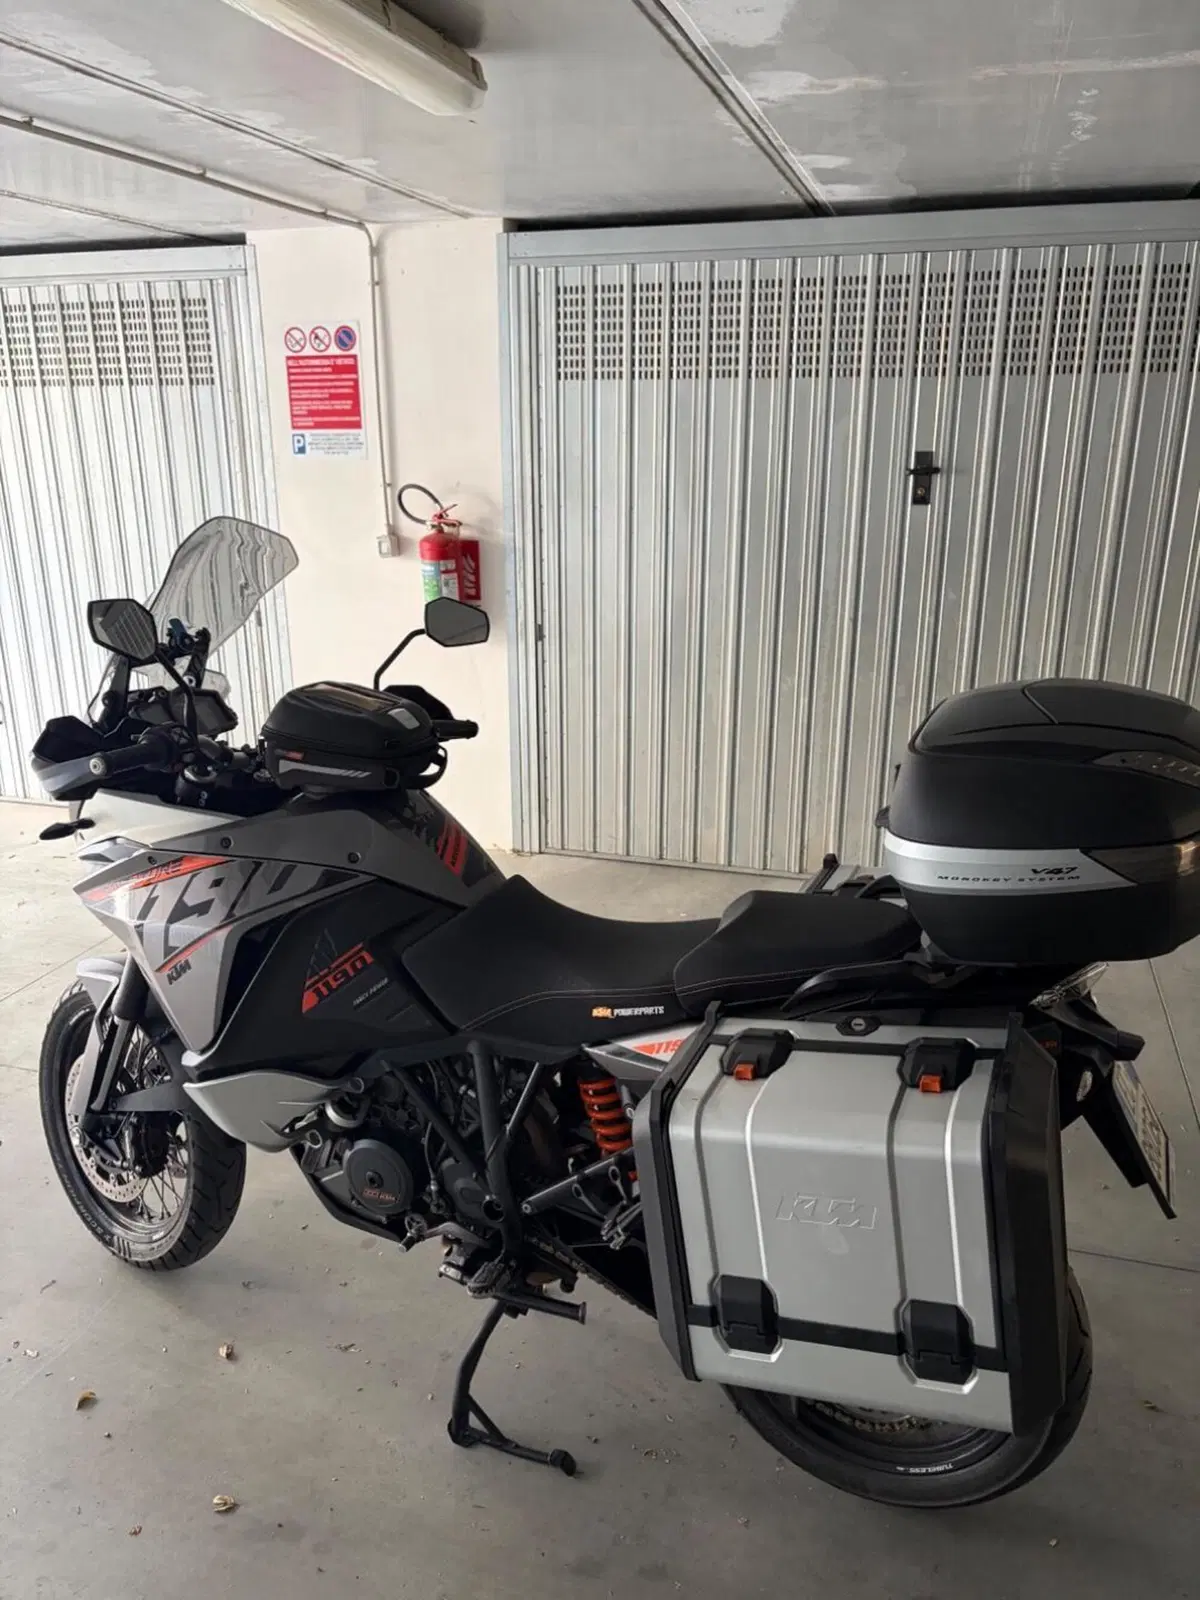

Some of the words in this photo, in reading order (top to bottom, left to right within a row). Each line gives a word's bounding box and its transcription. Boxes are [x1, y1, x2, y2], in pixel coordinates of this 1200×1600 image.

[1031, 866, 1079, 875] V47
[166, 959, 191, 985] KTM
[613, 1005, 665, 1017] POWERPARTS
[775, 1192, 878, 1231] KTM
[909, 1463, 954, 1473] TUBELESS
